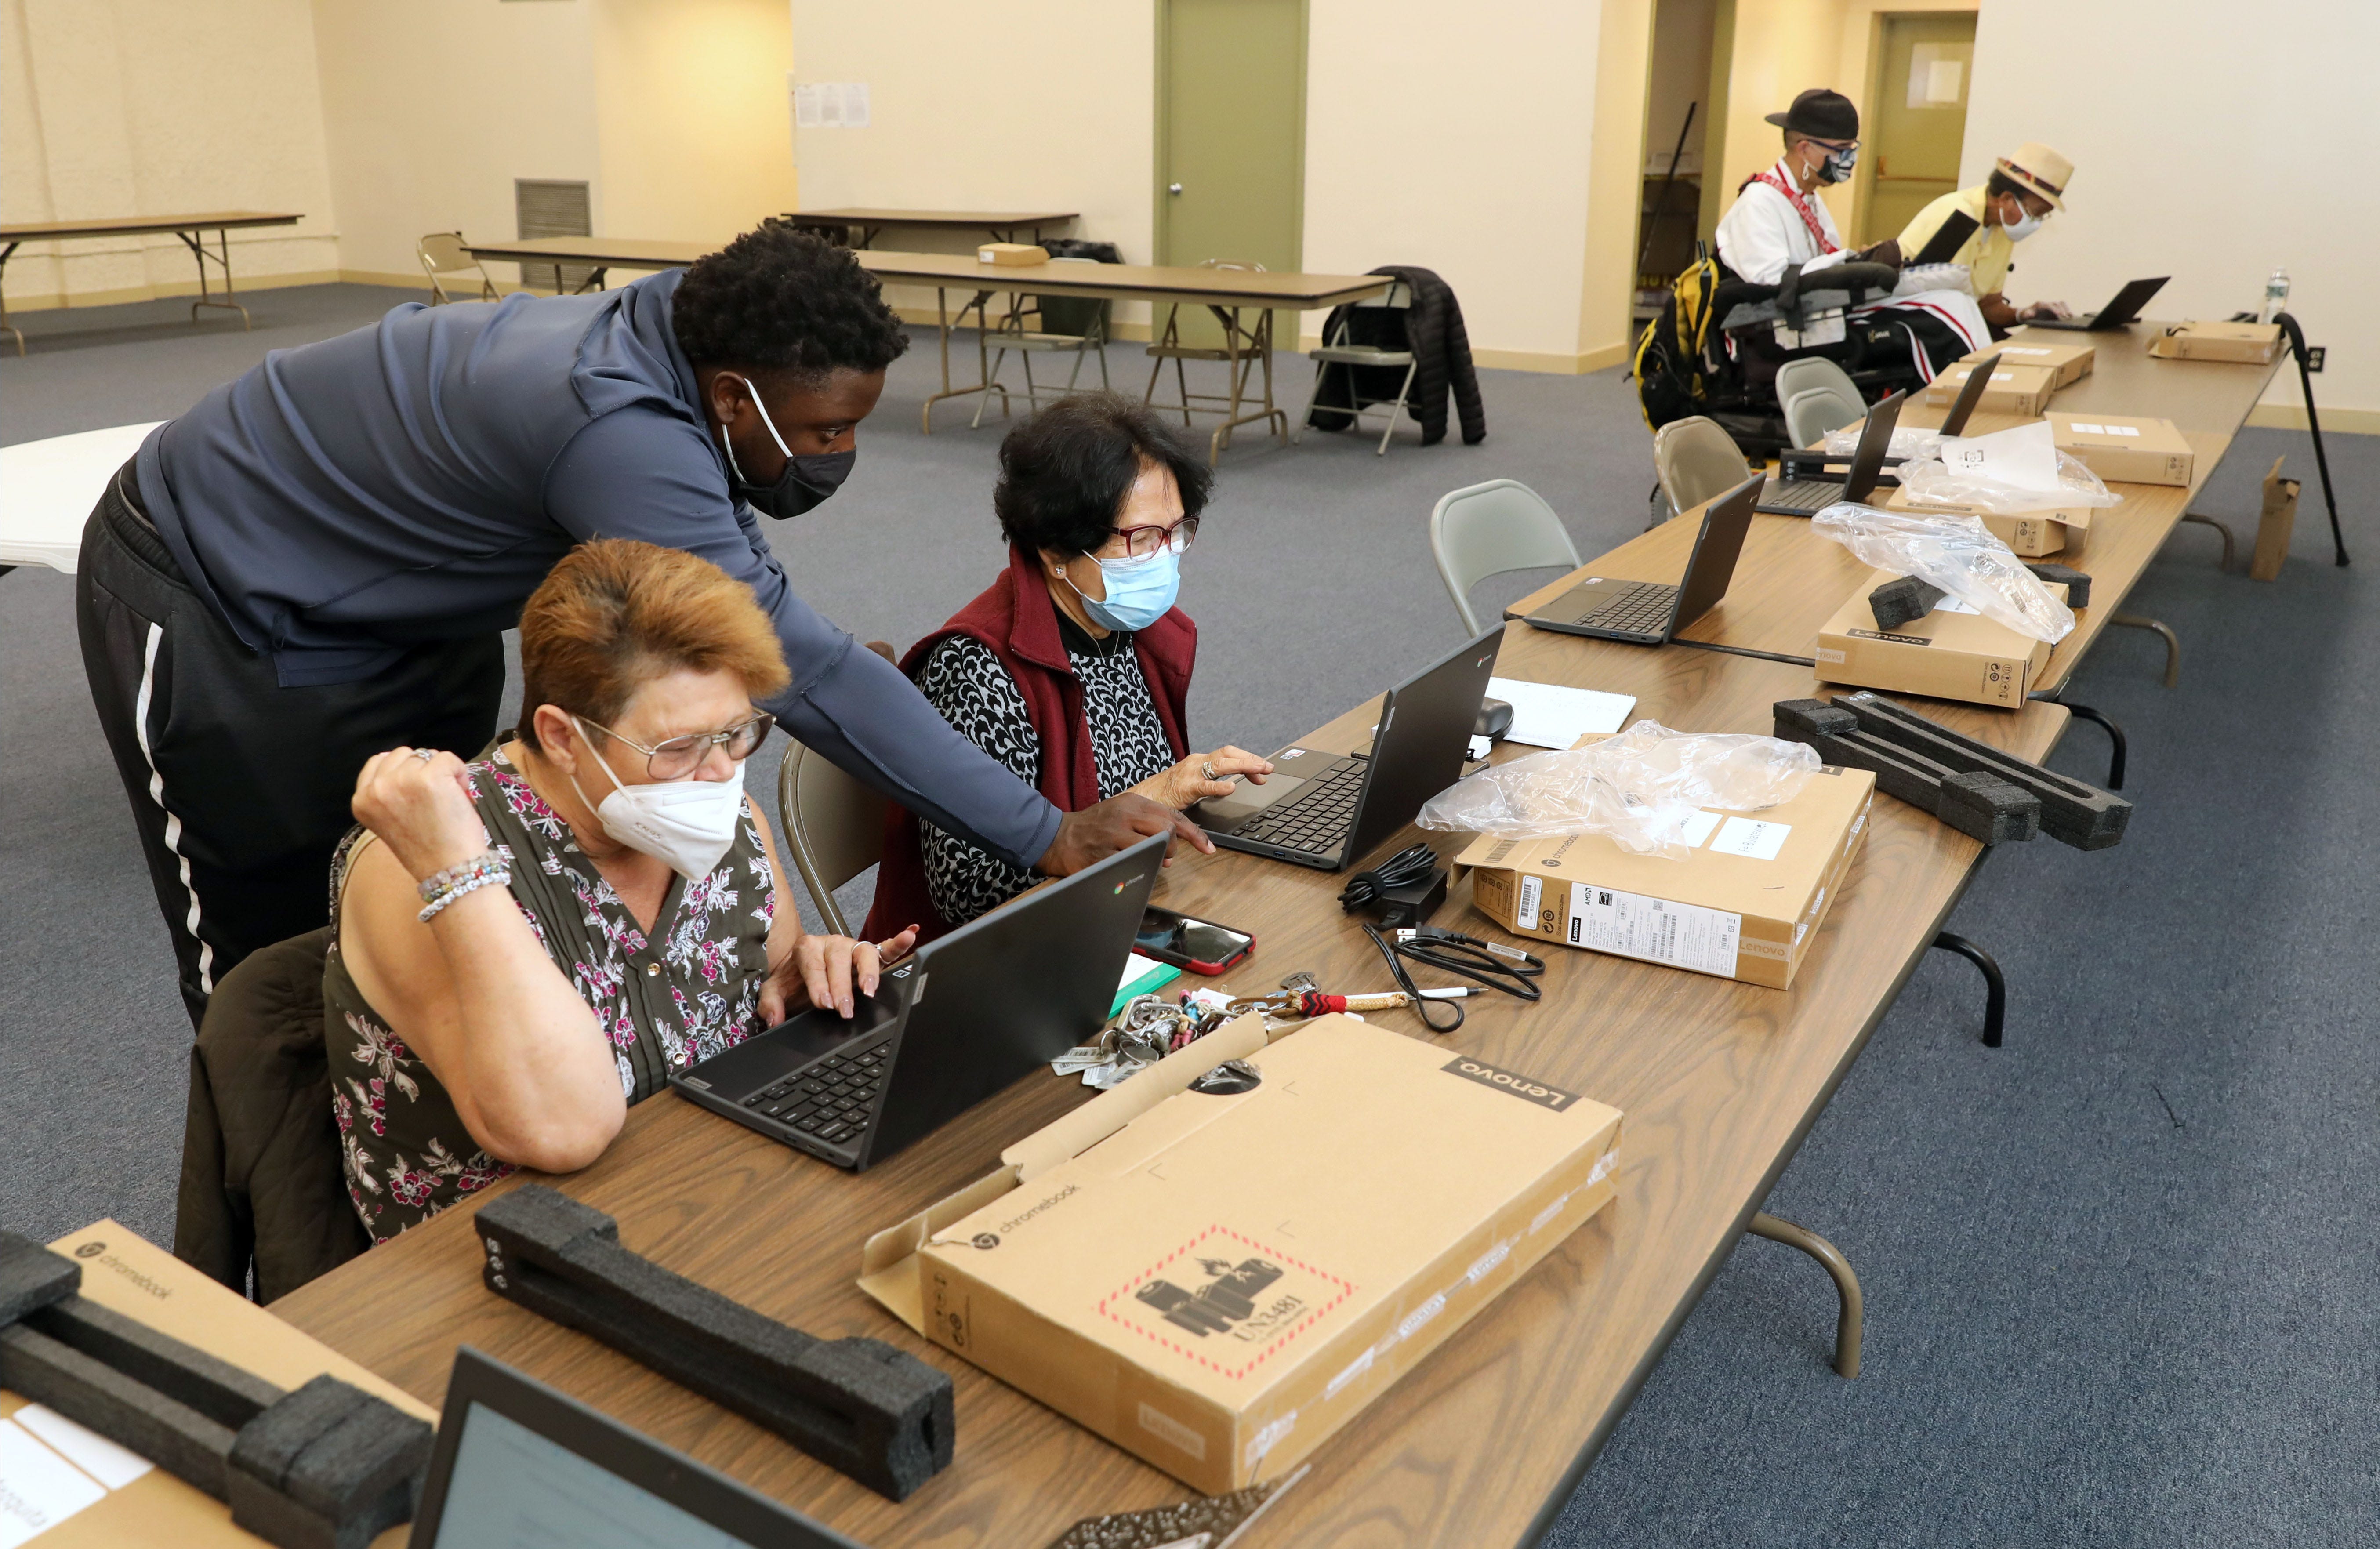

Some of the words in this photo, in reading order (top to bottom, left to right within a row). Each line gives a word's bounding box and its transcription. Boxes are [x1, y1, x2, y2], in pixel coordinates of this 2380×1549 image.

[1854, 630, 1923, 644] Lenovo
[1740, 940, 1785, 956] Lenovo
[1460, 1062, 1566, 1106] Lenovo
[999, 1184, 1081, 1233] chromebook
[100, 1255, 174, 1302] chromebook
[1233, 1294, 1302, 1342] UN3481
